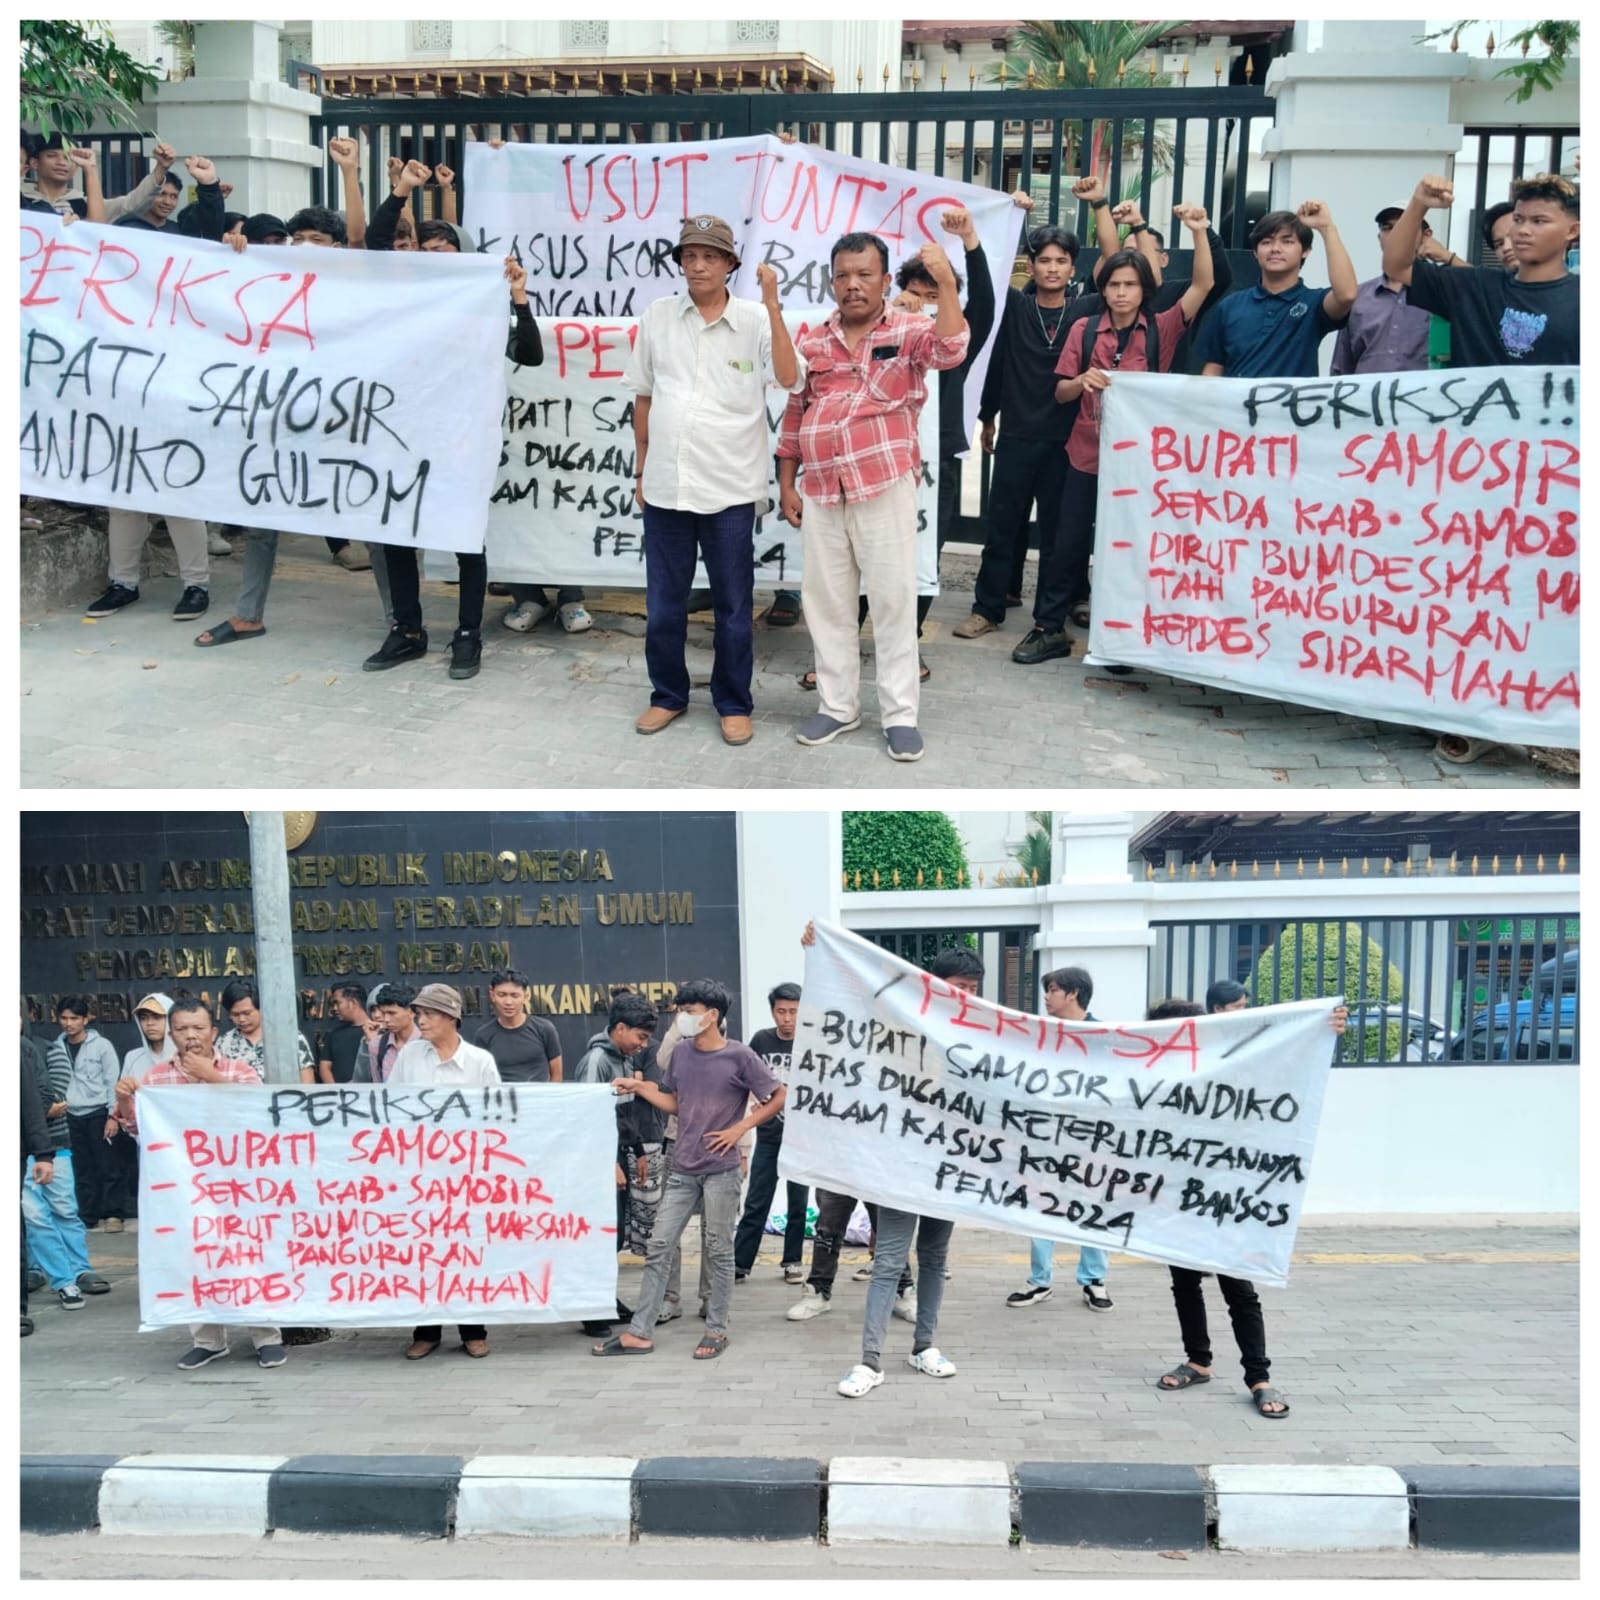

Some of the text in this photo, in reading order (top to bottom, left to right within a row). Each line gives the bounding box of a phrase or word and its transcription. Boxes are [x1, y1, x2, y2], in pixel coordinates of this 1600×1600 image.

[562, 153, 709, 224] USUT
[736, 152, 966, 256] TUNTAS
[477, 227, 588, 280] KASUS
[188, 364, 411, 450] SAMOSIR
[239, 443, 430, 537] GULTOM
[1151, 426, 1298, 481] BUPATI
[1338, 428, 1580, 508] SAMOSIR
[1151, 479, 1268, 530] SEKDA
[1150, 532, 1249, 573] DIRUT
[1262, 540, 1510, 607] BUMDESMA
[1251, 575, 1530, 652] PANGURURAN
[444, 848, 613, 885] INDONESIA
[292, 899, 379, 933] ADAN
[394, 894, 581, 929] PERADILAN
[596, 892, 695, 926] UMUM
[293, 944, 385, 977] INGGI
[399, 940, 512, 975] MEDAN
[920, 973, 1201, 1072] PERIKSA
[799, 1049, 865, 1087] ATAS
[822, 1010, 926, 1071] BUPATI
[946, 1043, 1112, 1106] SAMOSIR
[1129, 1078, 1299, 1123] VANDIKO
[185, 1129, 316, 1168] BUPATI
[348, 1124, 526, 1172] SAMOSIR
[792, 1085, 888, 1134] DALAM
[901, 1109, 1005, 1163] KASUS
[1179, 1178, 1290, 1227] BANSOS
[190, 1172, 296, 1207] SEKDA
[936, 1161, 1135, 1248] PENA 2024
[193, 1213, 281, 1240] DIRUT
[292, 1208, 471, 1240] BUMDESMA
[287, 1237, 483, 1272] PANGURURAN
[329, 1261, 551, 1306] SIPARMAHAN
